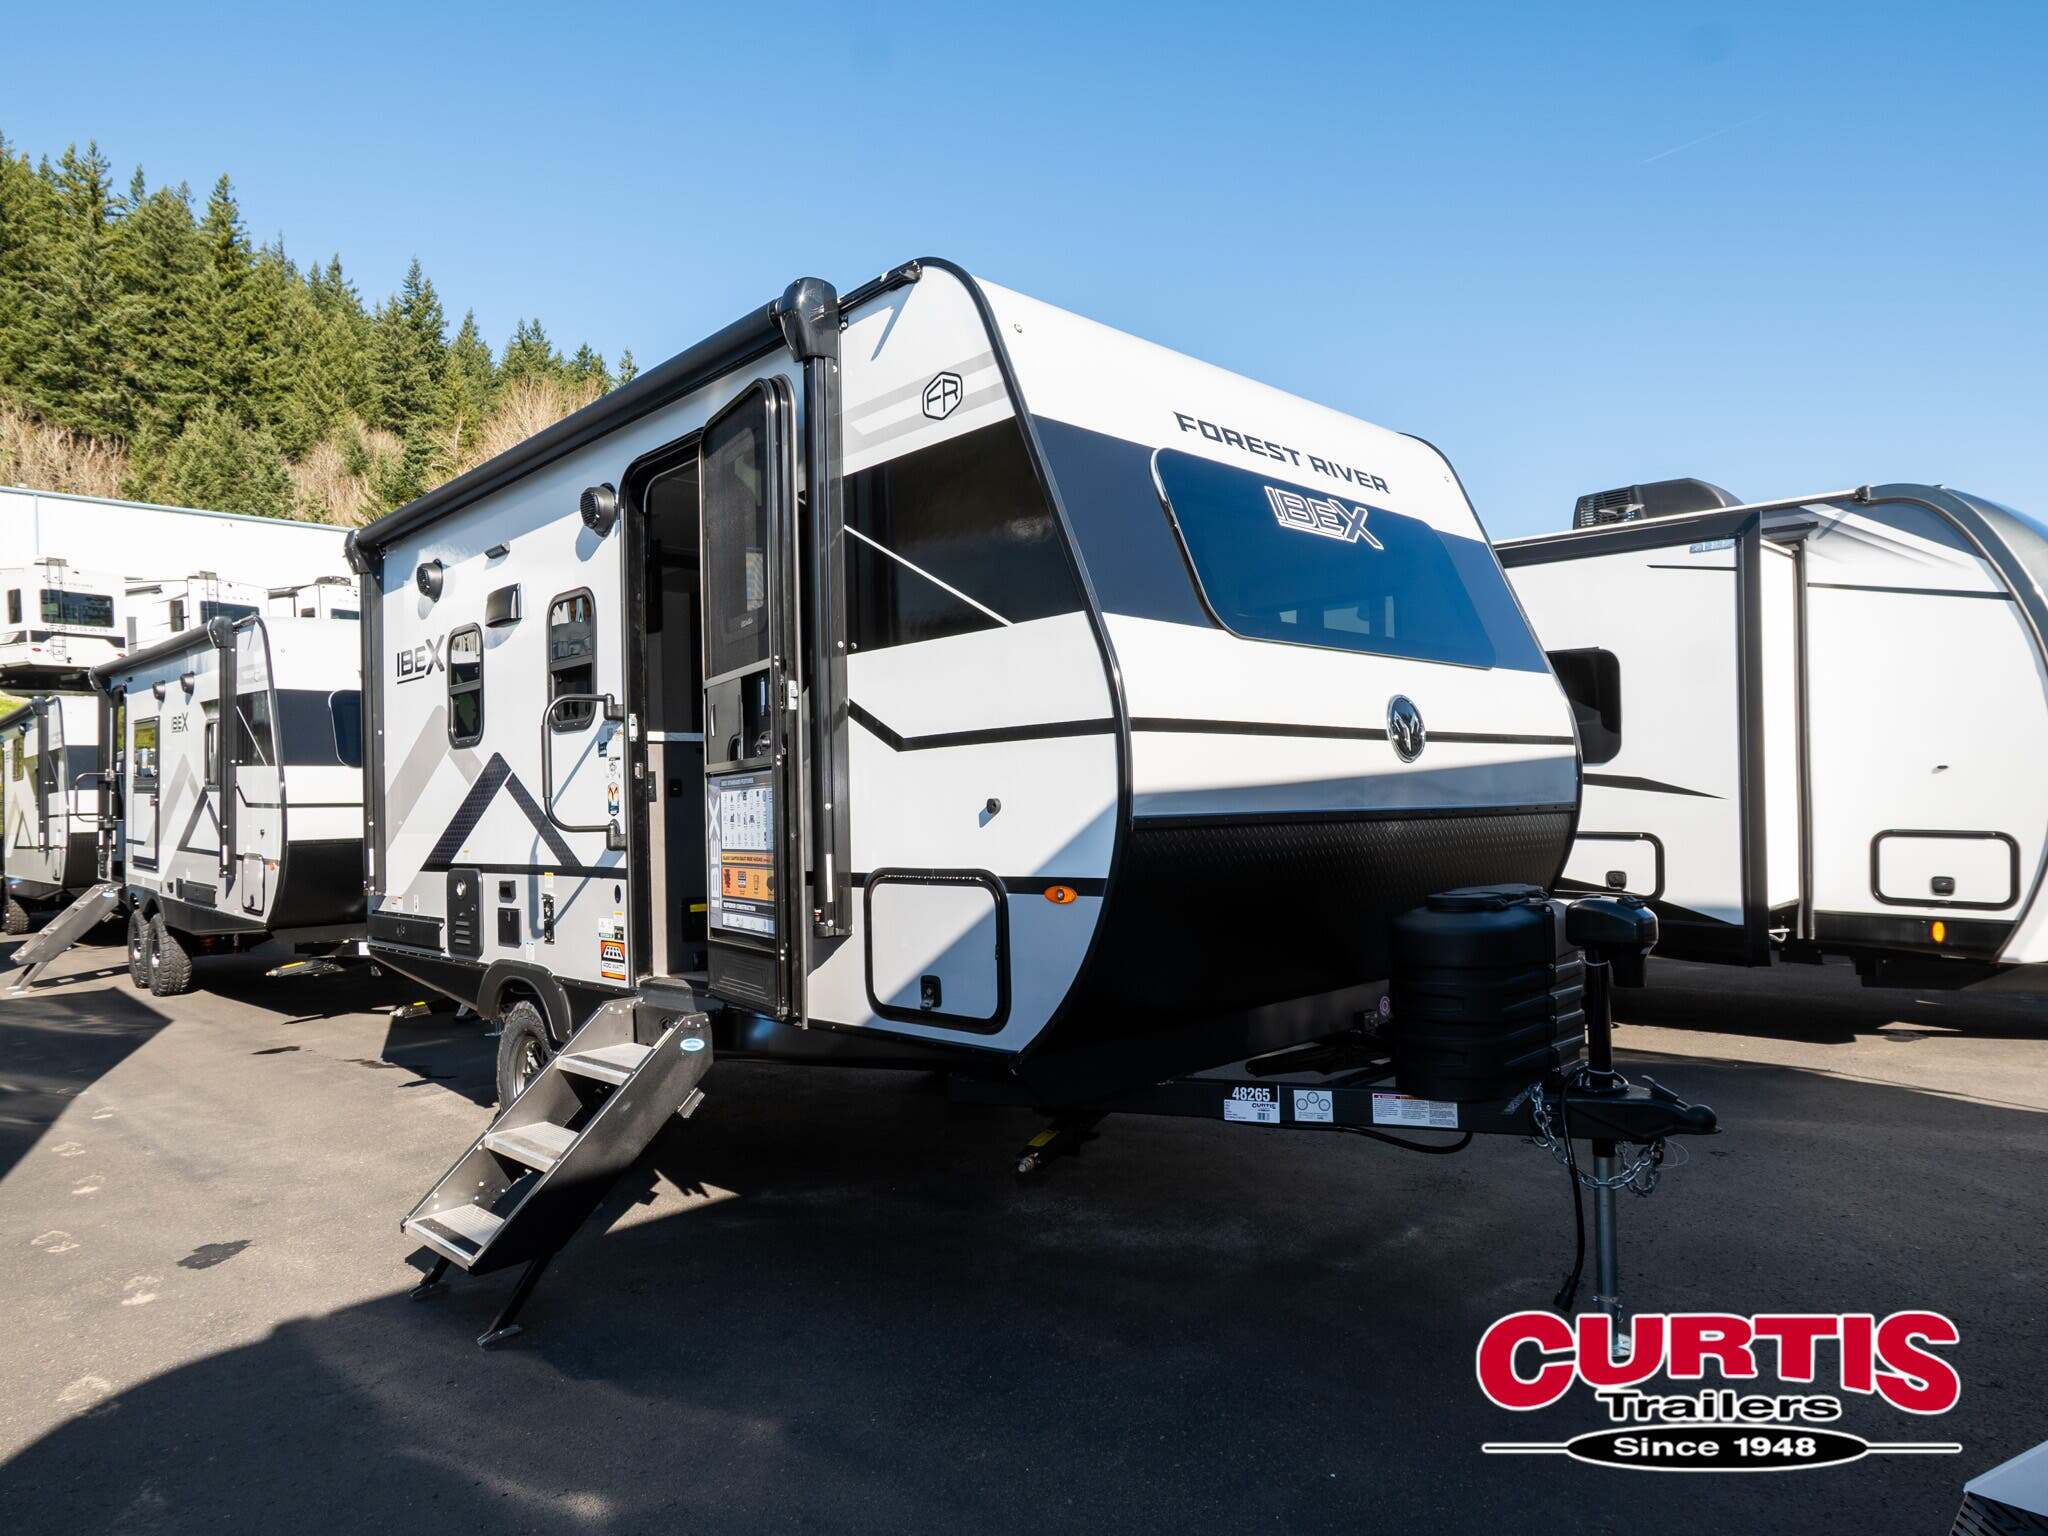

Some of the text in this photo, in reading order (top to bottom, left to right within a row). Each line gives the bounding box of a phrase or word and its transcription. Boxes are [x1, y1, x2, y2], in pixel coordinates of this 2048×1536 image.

[1173, 411, 1391, 494] FOREST RIVER
[1264, 485, 1385, 550] IBEX
[397, 634, 445, 684] IBEX
[1231, 1086, 1271, 1102] 48265
